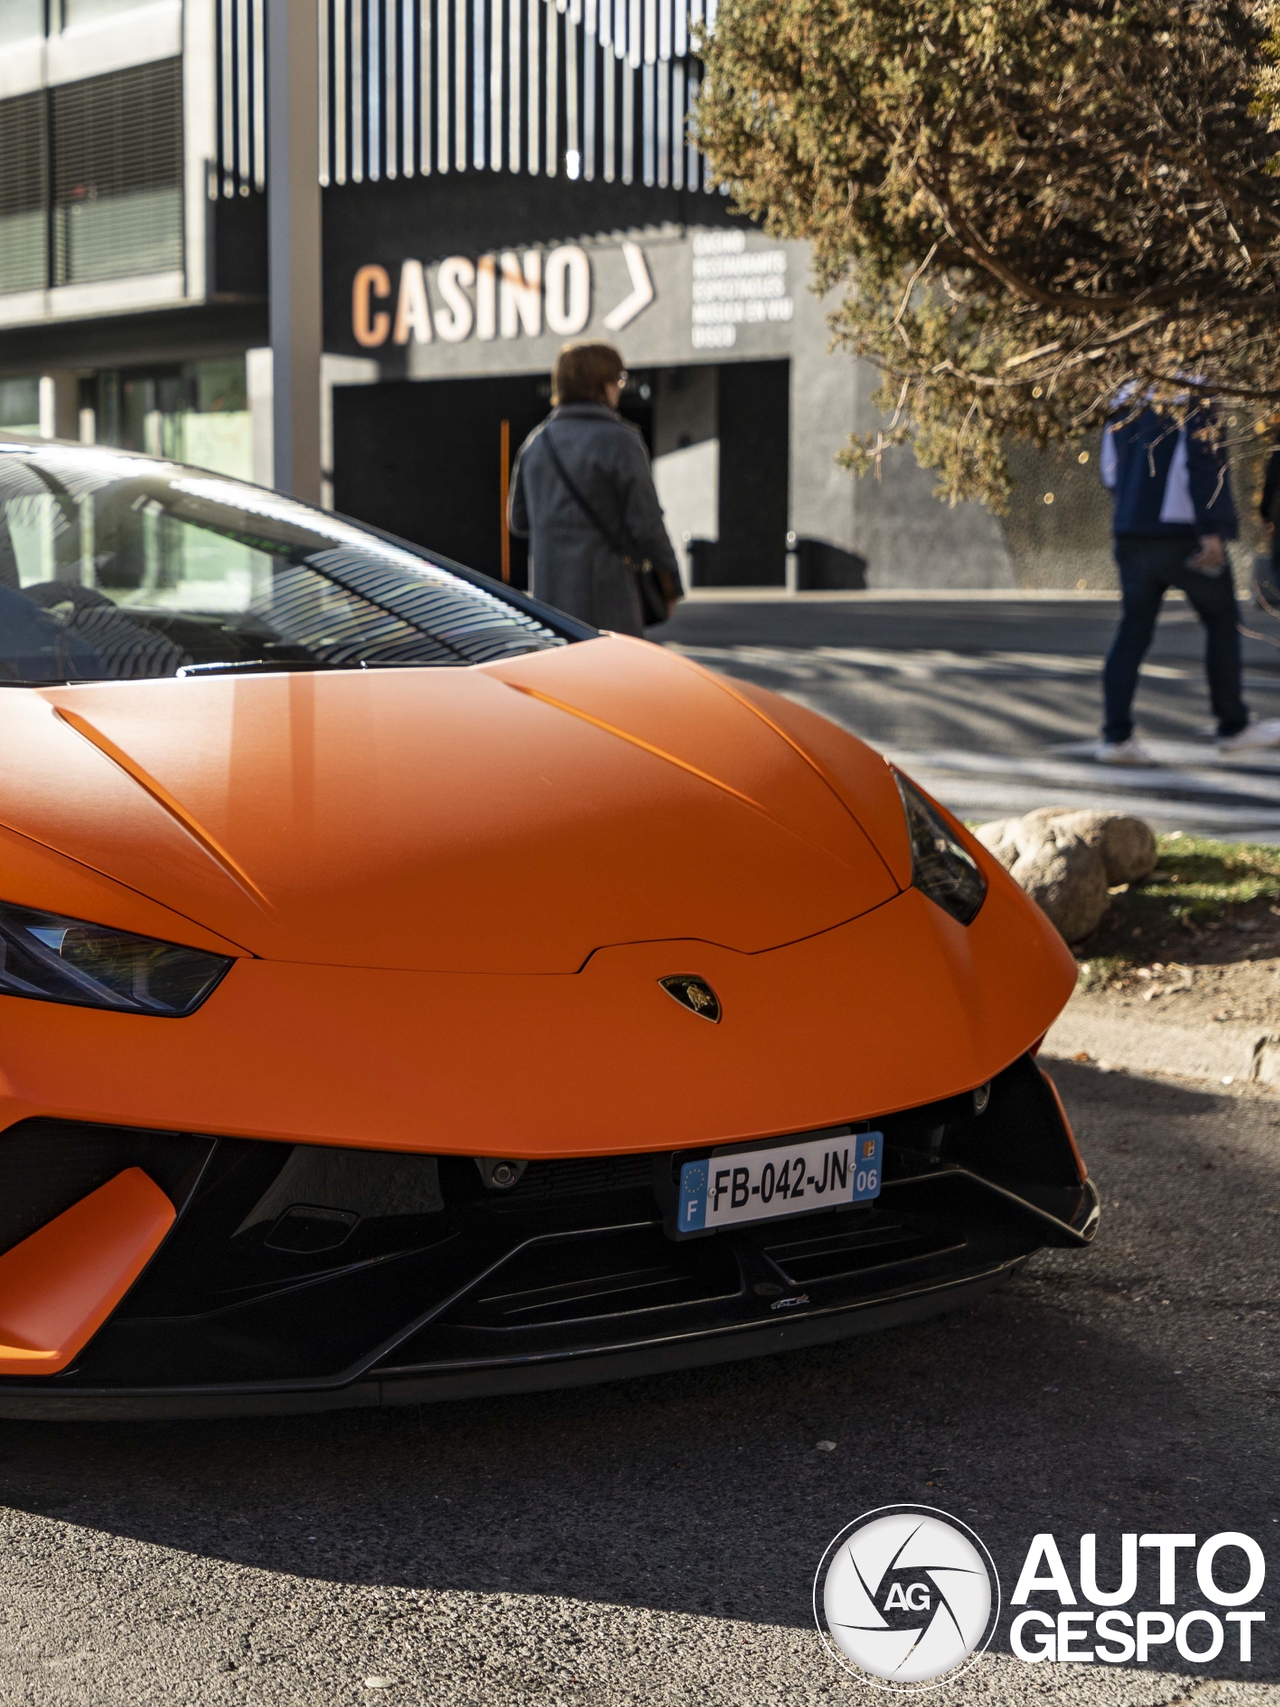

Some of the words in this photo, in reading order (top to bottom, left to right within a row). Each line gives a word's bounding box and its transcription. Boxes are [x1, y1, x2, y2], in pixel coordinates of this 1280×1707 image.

[352, 245, 590, 347] CASINO
[714, 1149, 849, 1212] FB-042-JN
[857, 1170, 877, 1192] 06
[687, 1200, 698, 1221] F
